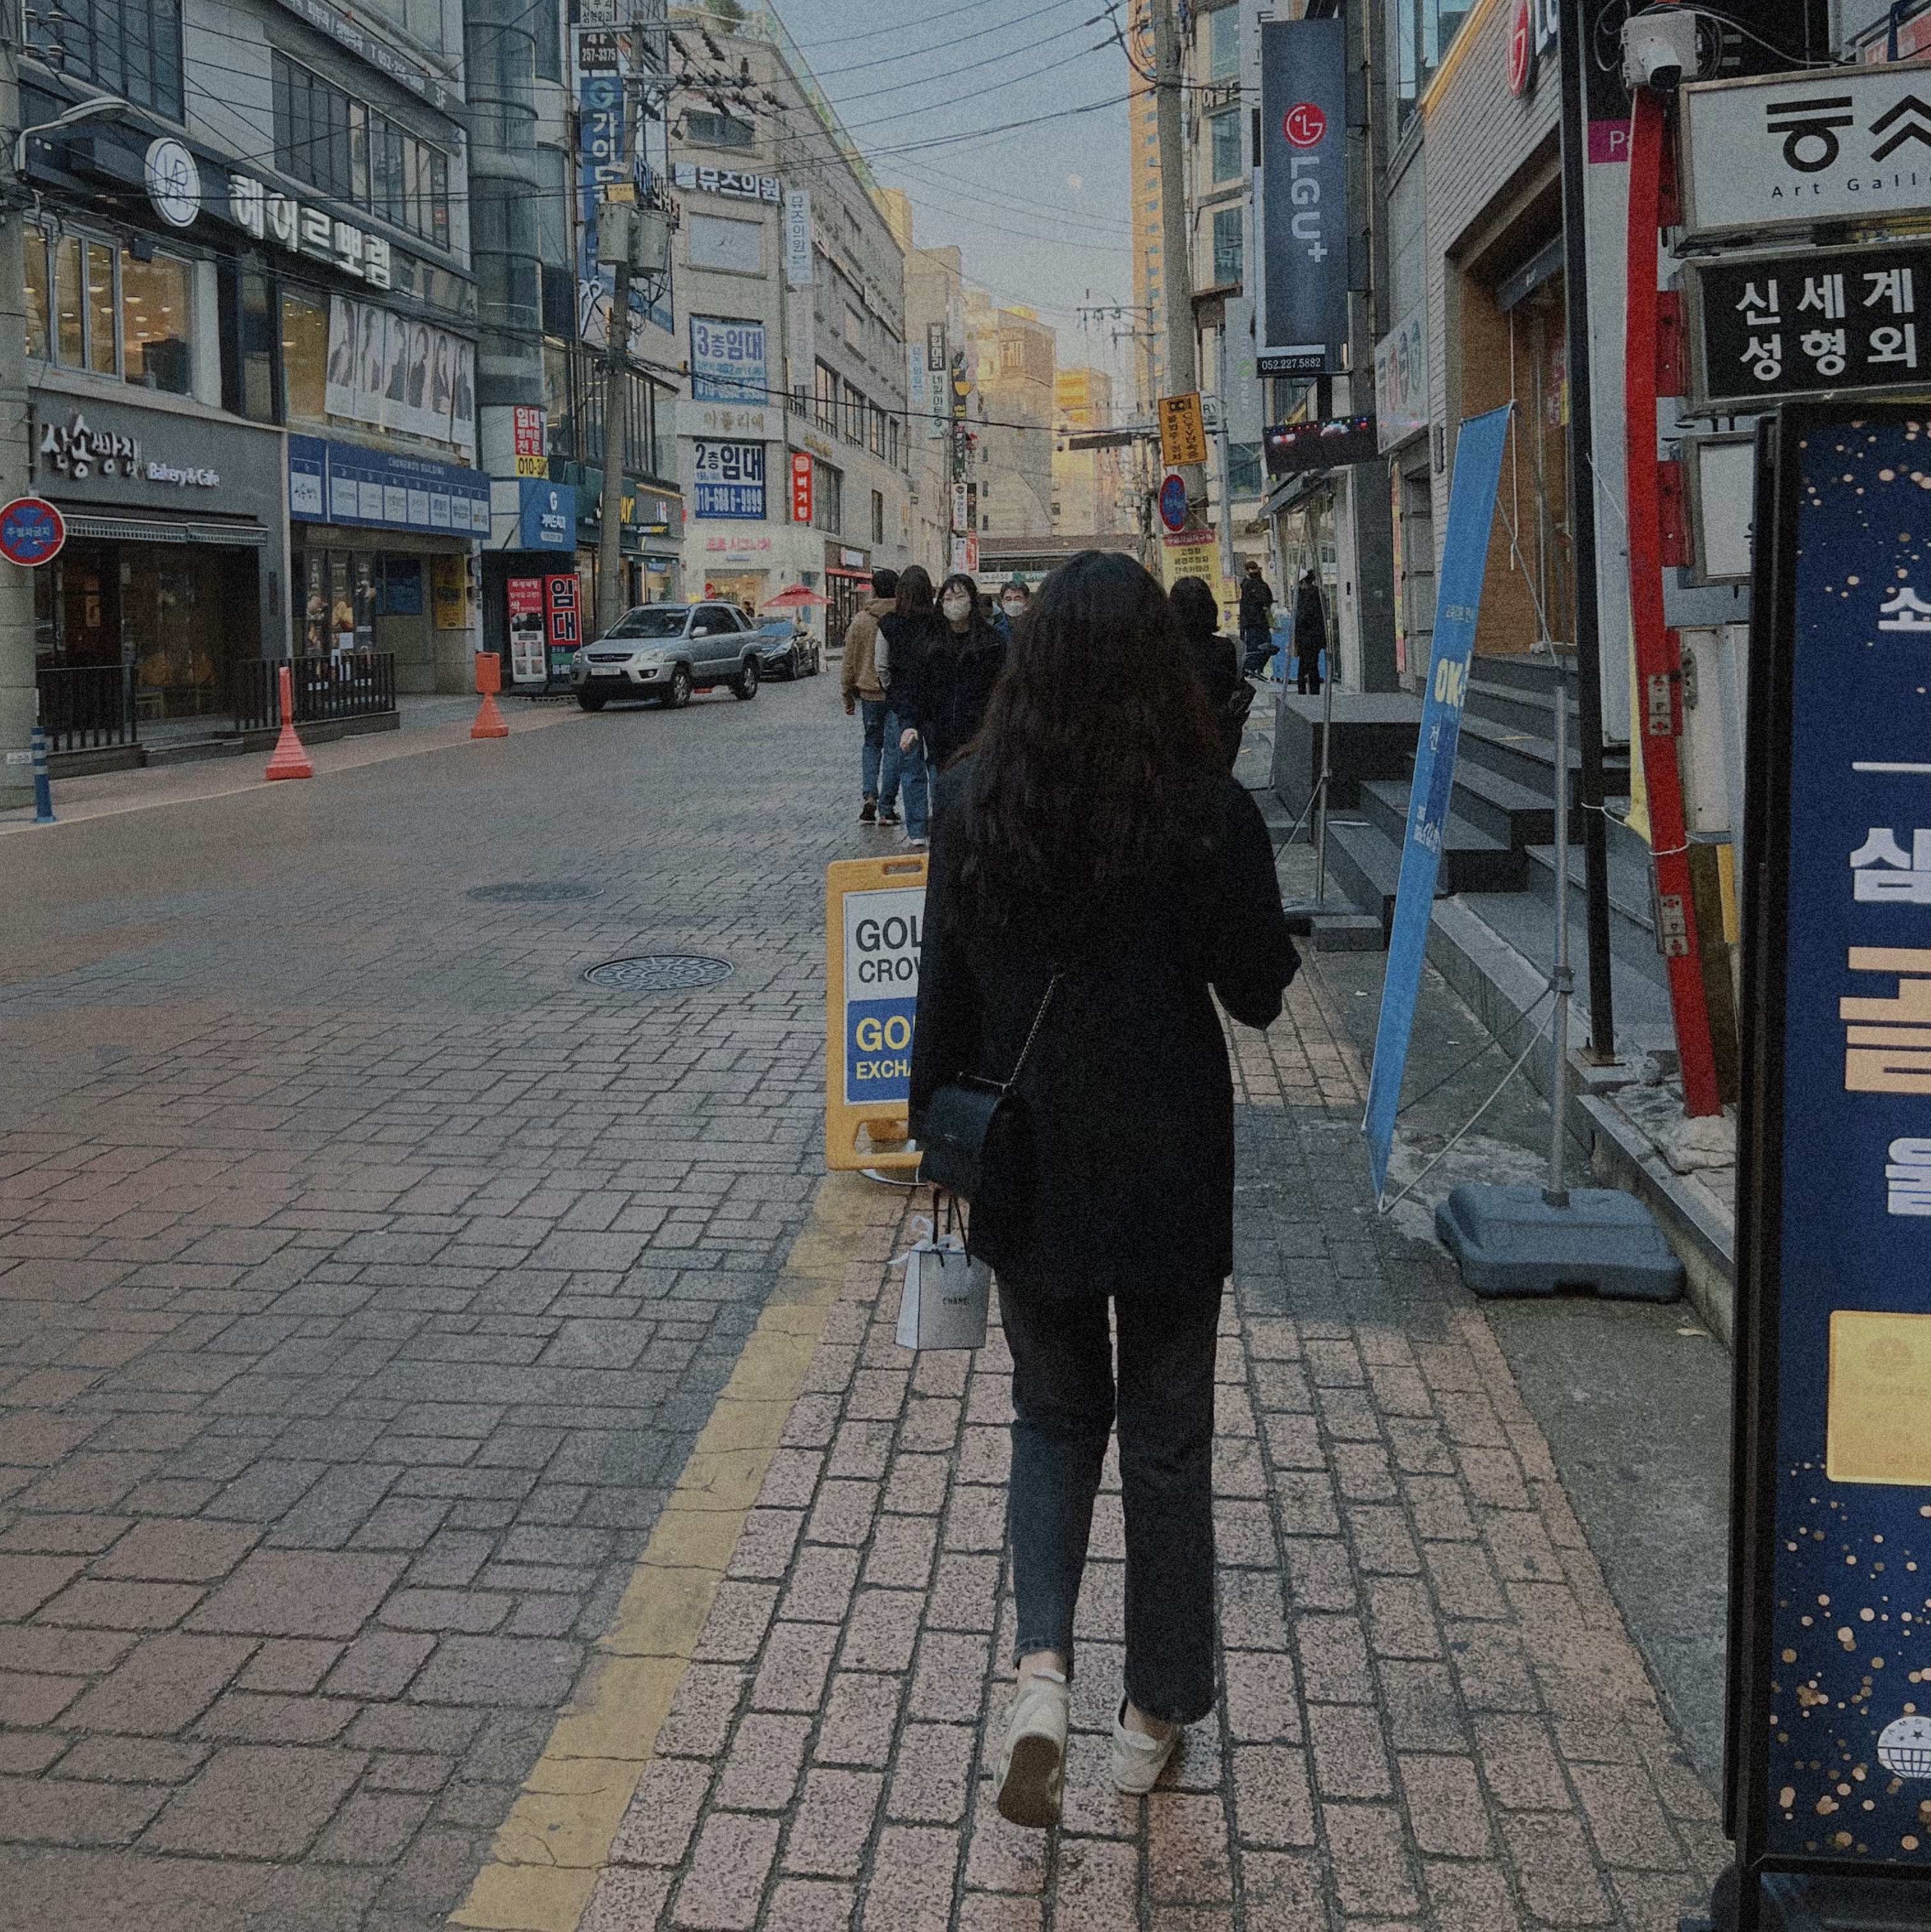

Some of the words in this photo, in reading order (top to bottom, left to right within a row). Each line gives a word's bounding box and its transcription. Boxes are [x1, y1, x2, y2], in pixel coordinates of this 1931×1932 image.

[698, 165, 781, 201] 뮤즈의원
[1771, 183, 1820, 199] Art
[1847, 172, 1931, 192] Gall
[1290, 155, 1329, 263] LGU+
[1735, 268, 1915, 327] 신세계
[1261, 356, 1321, 371] 052.227.5882
[515, 408, 540, 429] 임대
[551, 579, 576, 640] 임대
[859, 957, 920, 983] CRO
